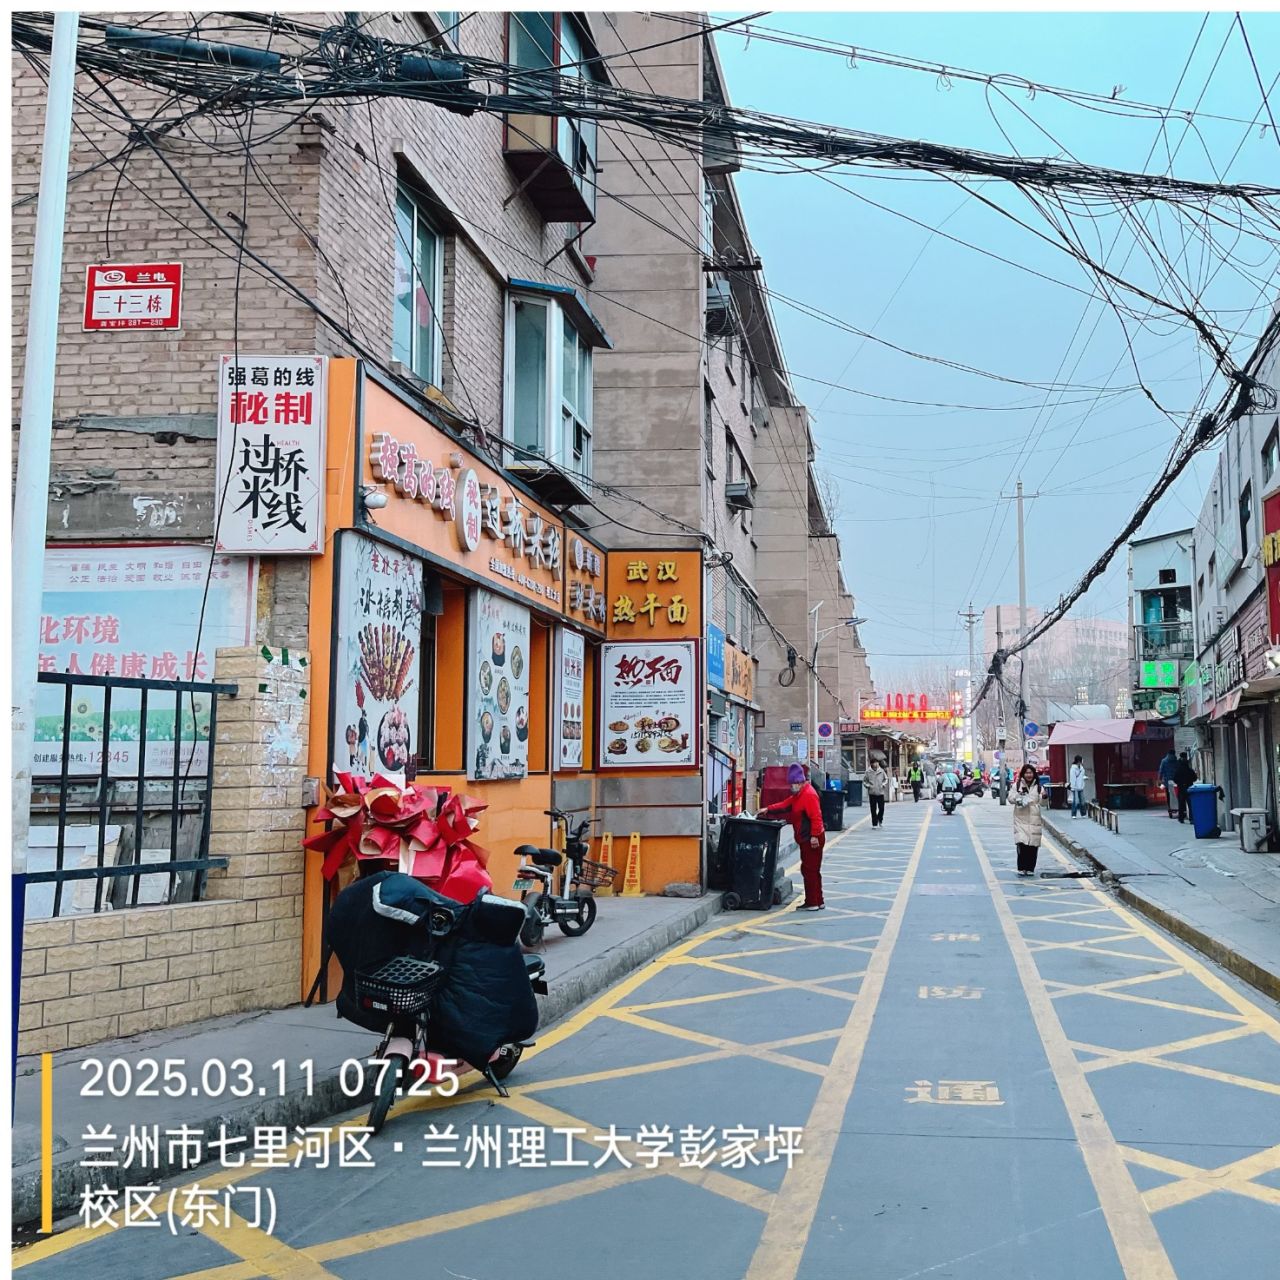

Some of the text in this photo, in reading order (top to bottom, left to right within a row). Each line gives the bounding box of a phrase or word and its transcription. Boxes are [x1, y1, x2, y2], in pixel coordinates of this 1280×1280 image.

[137, 272, 167, 282] 兰电
[97, 295, 162, 314] 二十三栋
[228, 366, 315, 387] 强葛的线
[230, 391, 313, 426] 秘制
[627, 560, 680, 582] 武汉
[614, 594, 690, 625] 热干面
[613, 654, 682, 689] 热干面
[1027, 740, 1036, 751] 10
[904, 1080, 1005, 1106] 通
